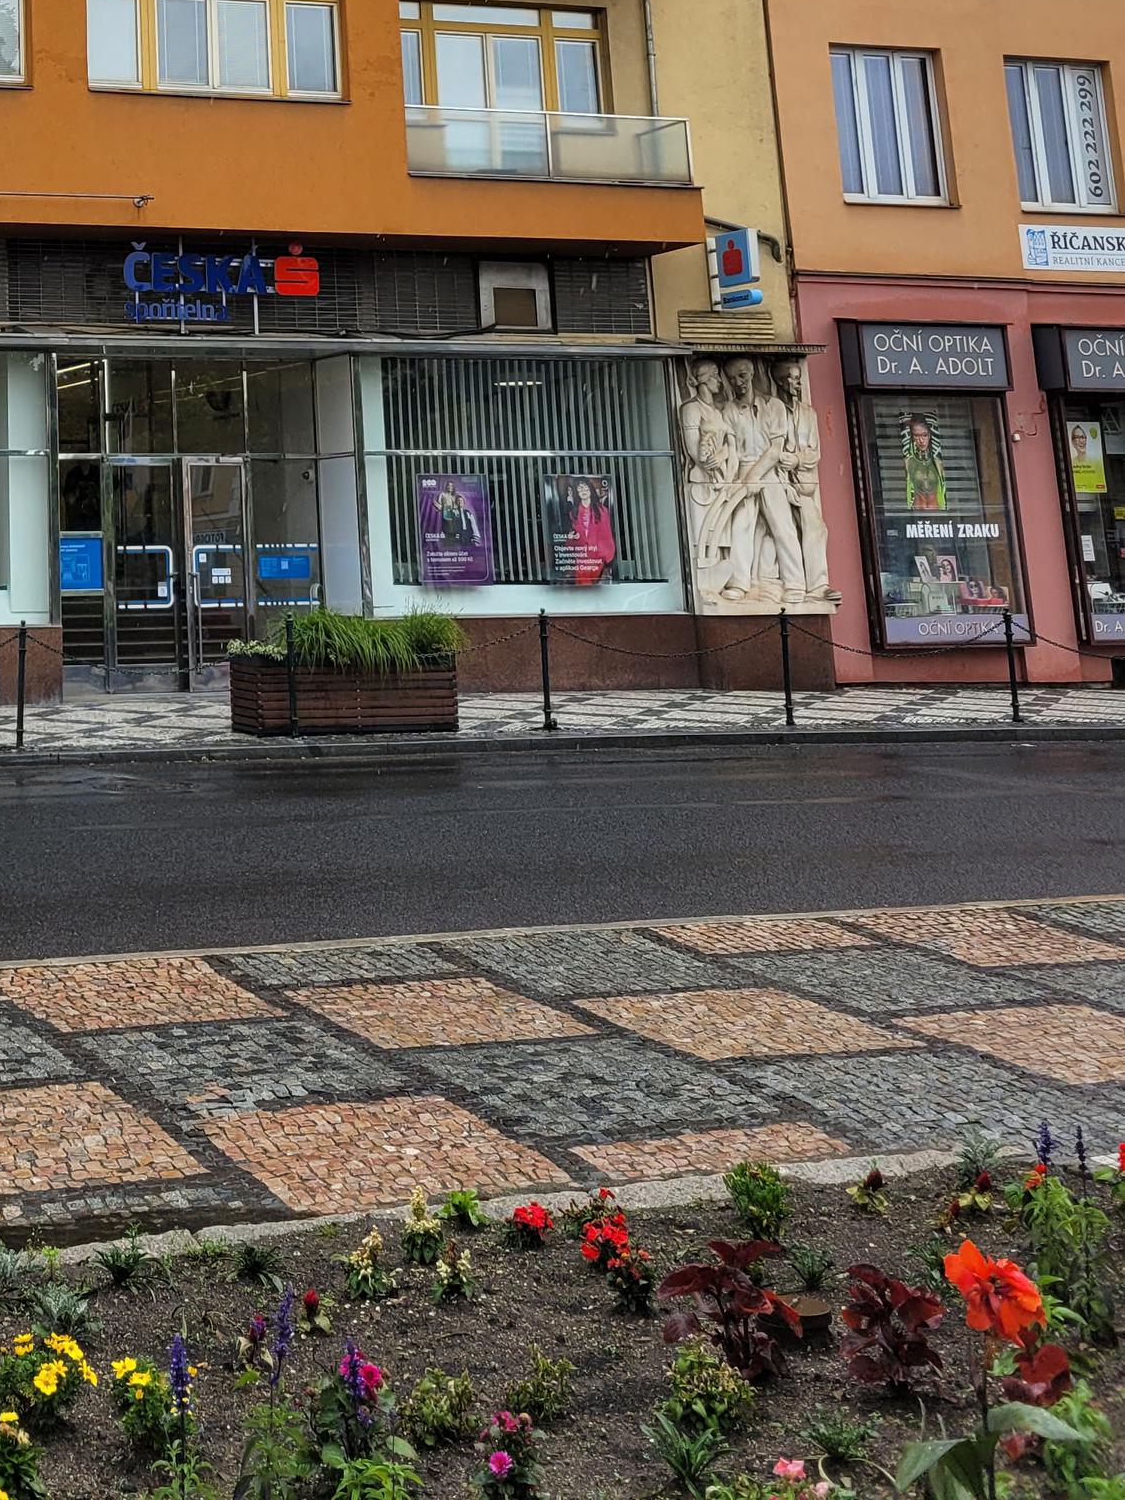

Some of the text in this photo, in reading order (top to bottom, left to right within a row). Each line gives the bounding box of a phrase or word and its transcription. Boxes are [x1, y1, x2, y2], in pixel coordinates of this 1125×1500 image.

[1076, 74, 1103, 198] 602 222 299
[123, 241, 268, 295] ČESKÁ
[1053, 256, 1094, 266] REALITNÍ
[123, 298, 231, 324] spořitelna
[874, 329, 994, 353] OČNÍ OPTIKA
[1078, 334, 1125, 357] OČNÍ
[877, 356, 994, 376] Dr. A. ADOLT
[1082, 361, 1106, 378] Dr.
[906, 520, 1000, 538] MĚŘENÍ ZRAKU
[918, 618, 952, 636] OČNÍ
[1095, 620, 1111, 633] Dr.
